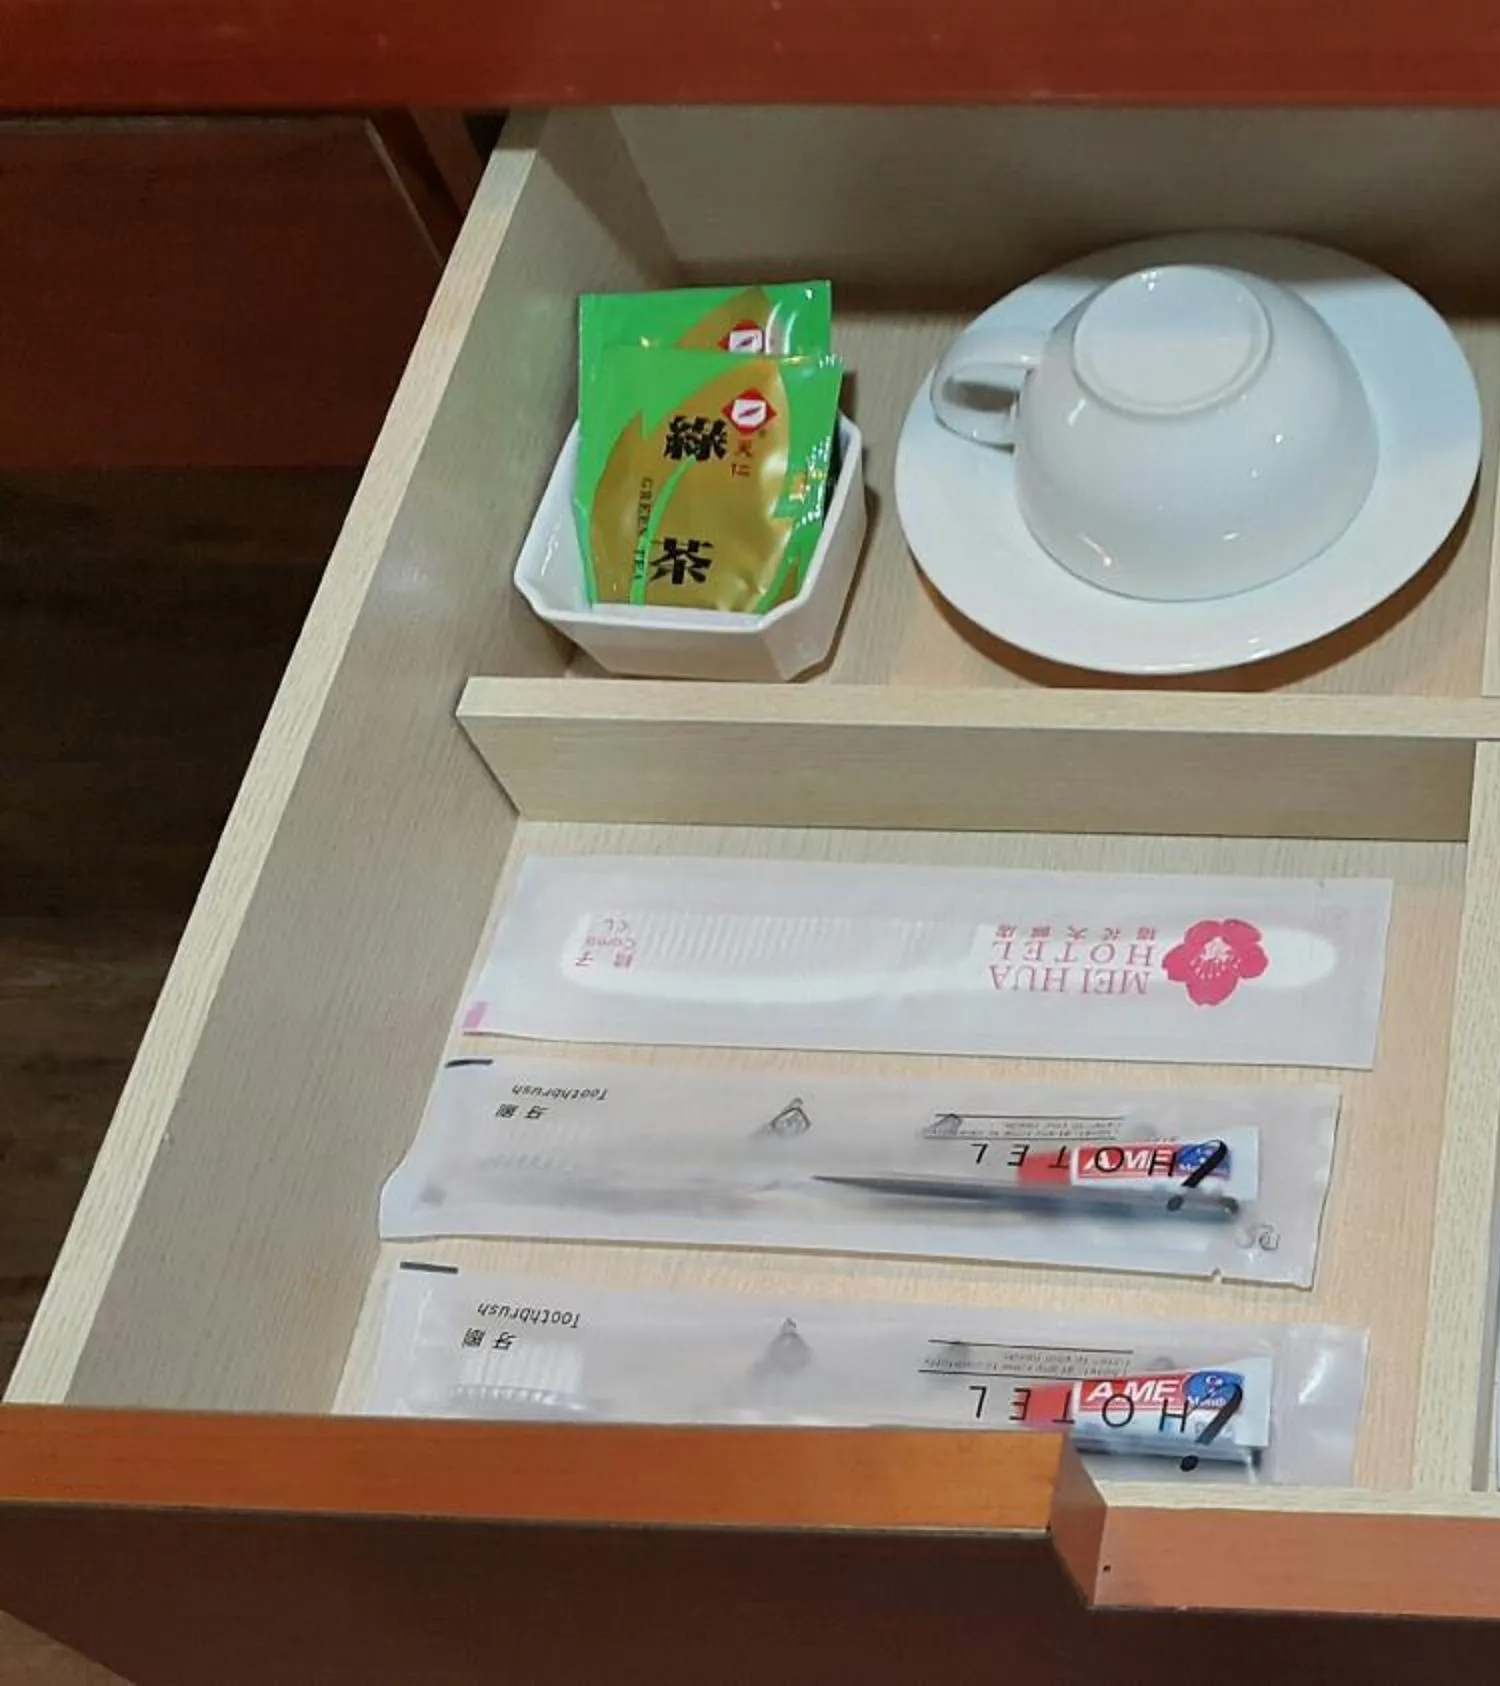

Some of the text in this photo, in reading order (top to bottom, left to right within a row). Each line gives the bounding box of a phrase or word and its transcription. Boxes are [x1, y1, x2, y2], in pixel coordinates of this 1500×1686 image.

[633, 477, 654, 580] GREEN TEA
[991, 940, 1154, 967] HOTEL
[989, 963, 1151, 994] MEI HUA
[511, 1084, 609, 1102] Toothbrush
[477, 1302, 581, 1328] Toothbrush
